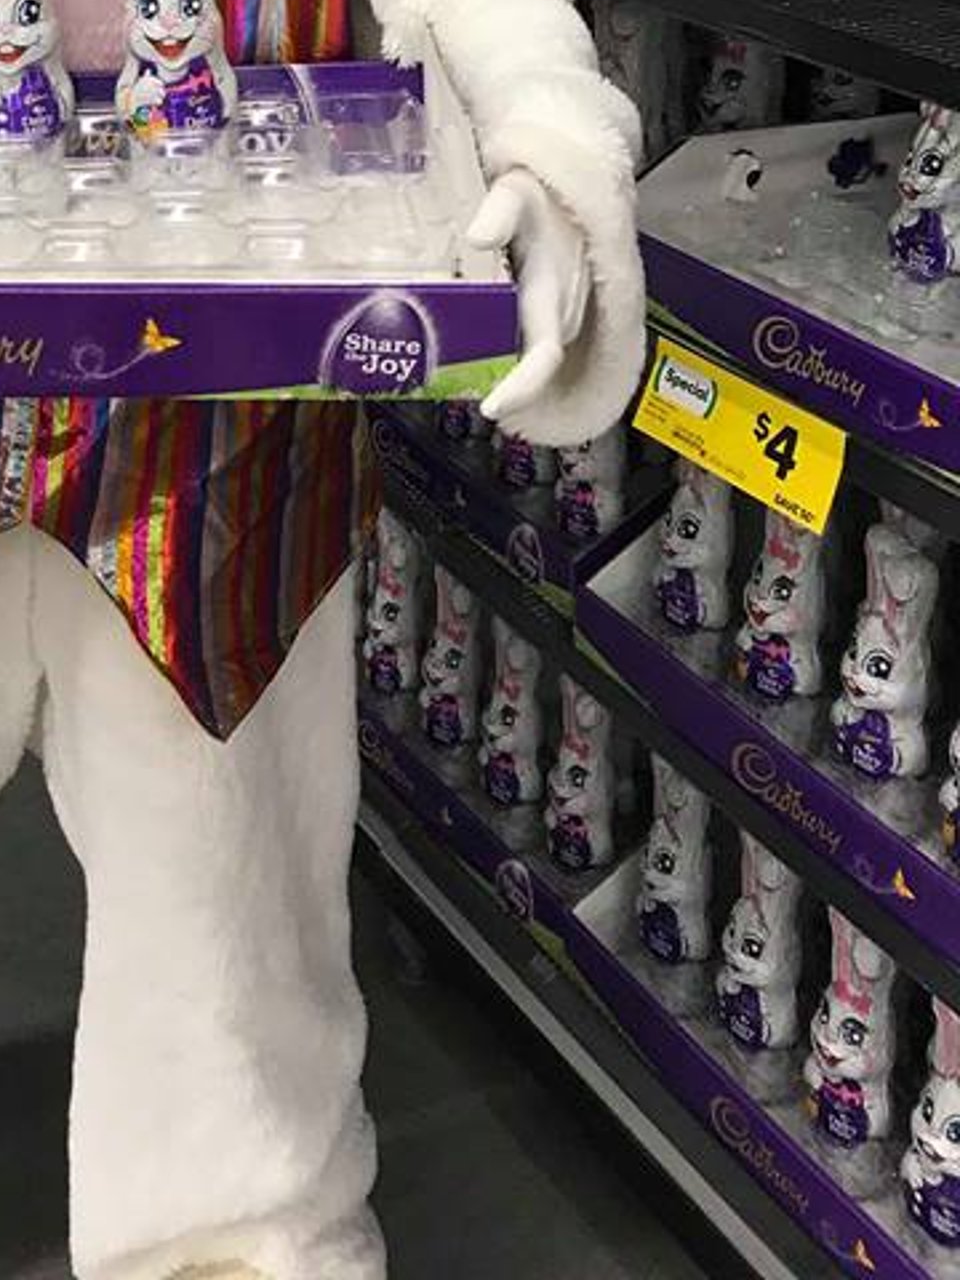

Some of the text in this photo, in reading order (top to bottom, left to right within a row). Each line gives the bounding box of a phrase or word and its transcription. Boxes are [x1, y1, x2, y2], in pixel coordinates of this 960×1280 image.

[344, 332, 421, 355] Share
[362, 354, 417, 382] Joy
[753, 316, 866, 407] Cadbury
[664, 367, 710, 403] Special
[754, 412, 798, 480] $4
[732, 740, 842, 855] Cadbury
[710, 1095, 809, 1214] Cadbury
